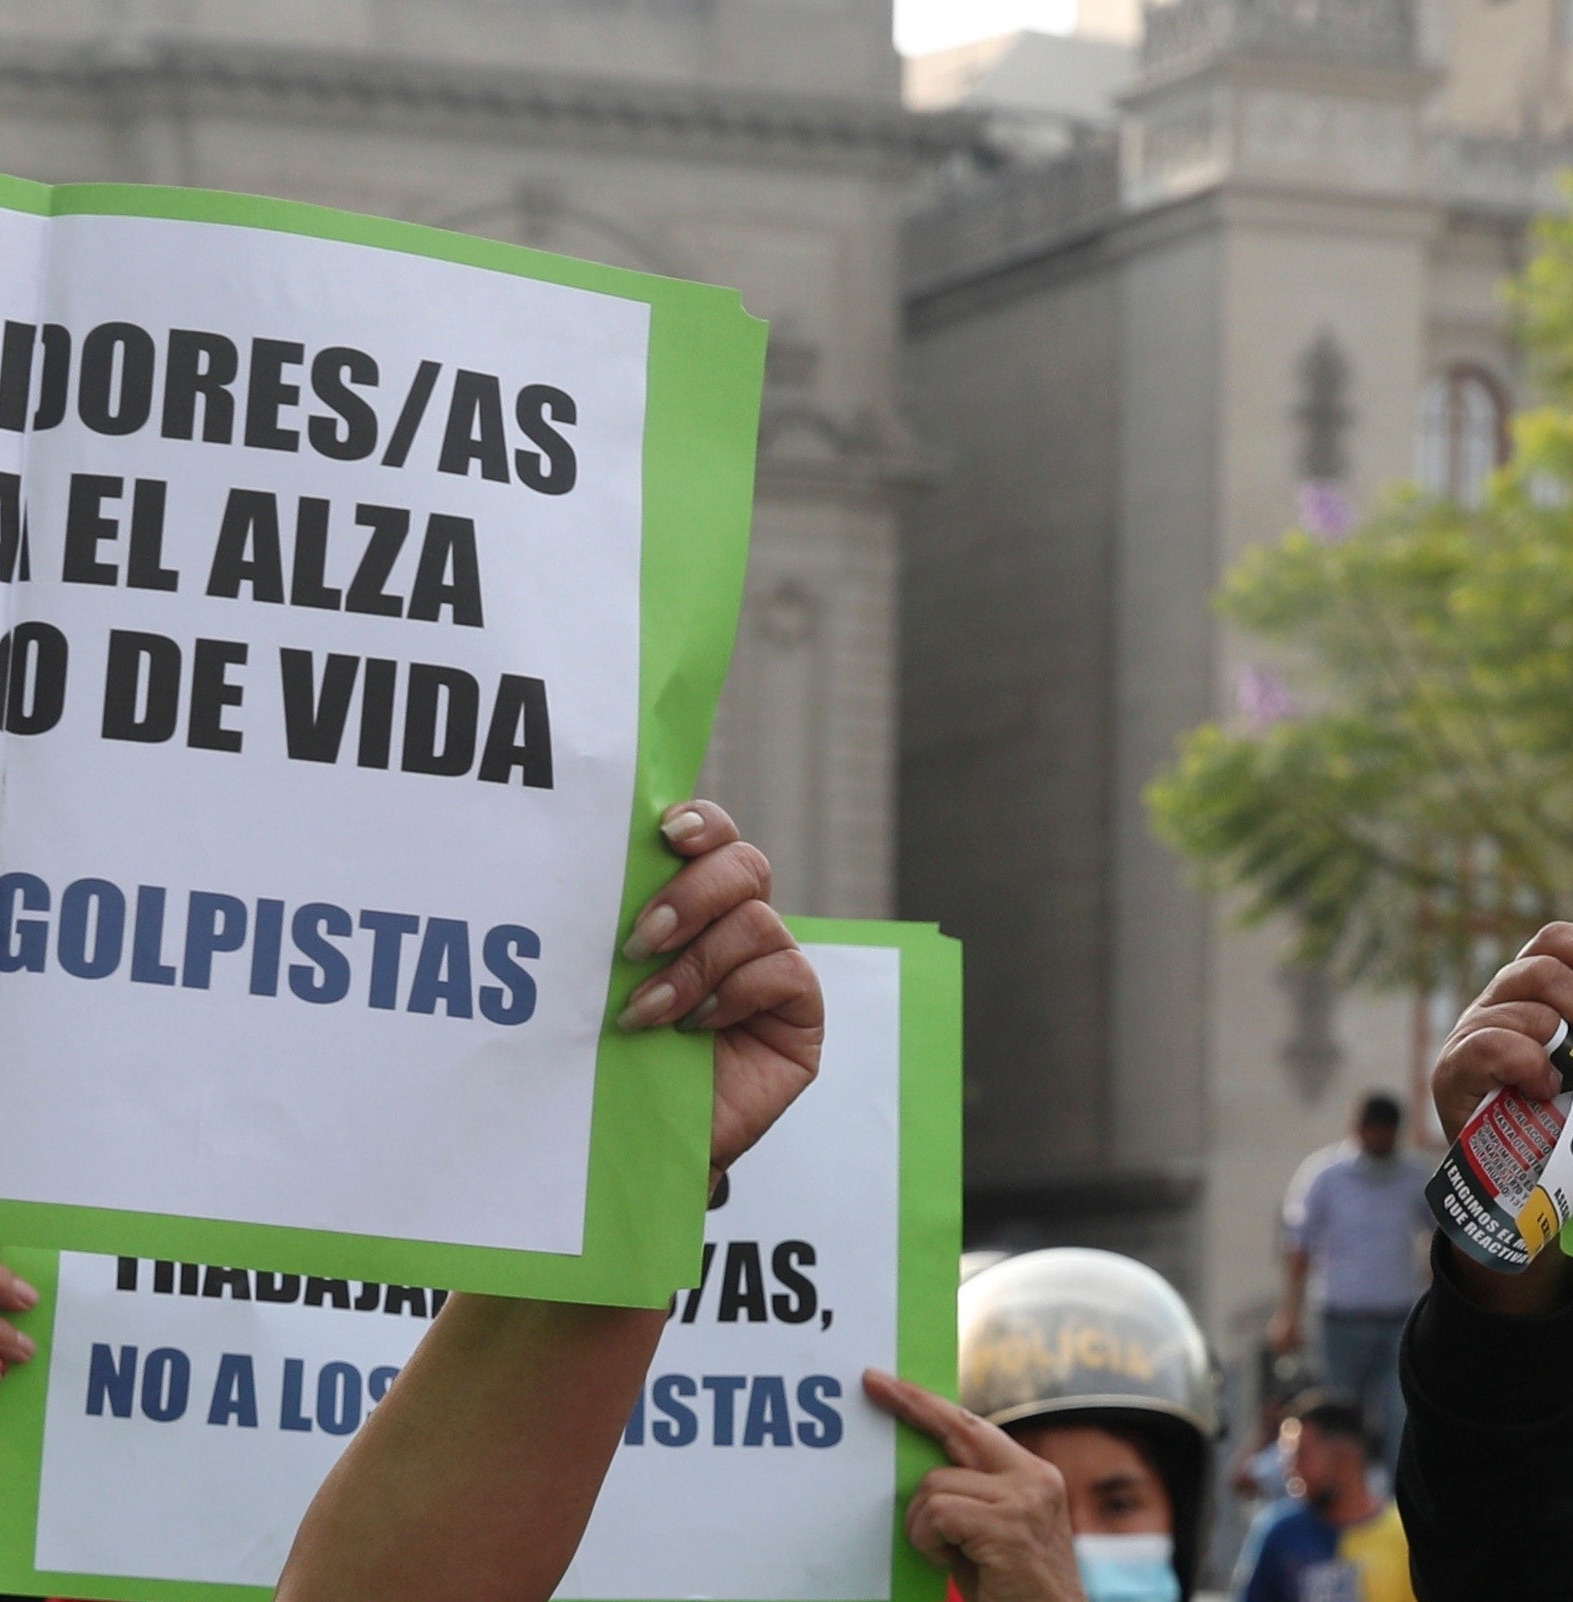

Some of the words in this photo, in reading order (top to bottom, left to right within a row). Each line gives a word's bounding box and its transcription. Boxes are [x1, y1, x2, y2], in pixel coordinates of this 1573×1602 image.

[61, 472, 180, 593] EL
[205, 487, 484, 629] ALZA
[100, 628, 249, 754] DE
[279, 647, 554, 790] VIDA
[1443, 1192, 1470, 1226] QUE
[85, 1343, 191, 1423] NO
[206, 1353, 259, 1428] A
